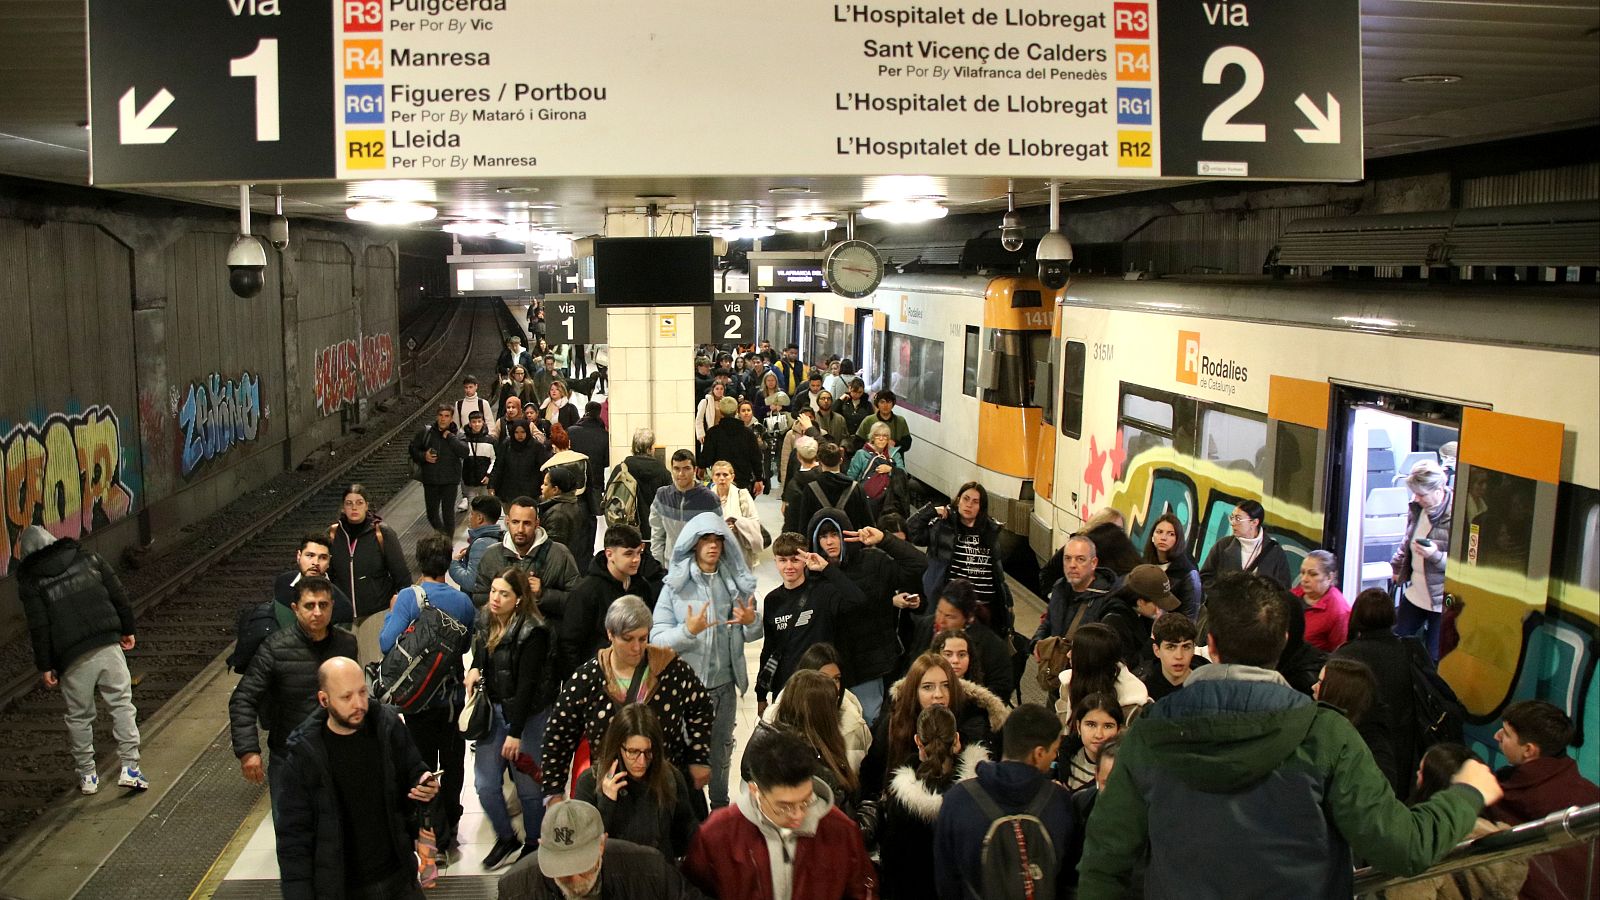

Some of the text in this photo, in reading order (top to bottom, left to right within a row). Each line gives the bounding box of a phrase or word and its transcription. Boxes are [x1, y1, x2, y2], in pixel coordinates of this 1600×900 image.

[344, 0, 382, 24] R3
[971, 8, 999, 26] de
[1006, 9, 1107, 33] Llobregat
[1115, 9, 1148, 32] R3
[1202, 0, 1249, 27] via
[390, 19, 493, 33] Per Por By Vic
[345, 47, 382, 71] R4
[390, 48, 490, 67] Manresa
[863, 40, 1107, 65] Sant Vicenç de Calders
[1117, 52, 1150, 74] R4
[878, 65, 1108, 81] Per Por By Vilafranca del Penedès
[230, 38, 280, 142] 1
[391, 82, 607, 105] Figueres / Portbou
[1202, 45, 1266, 142] 2
[346, 95, 384, 114] RG1
[973, 95, 1000, 113] de
[1007, 95, 1108, 118] Llobregat
[1118, 97, 1151, 115] RG1
[391, 110, 415, 122] Per
[420, 110, 444, 121] Por
[449, 110, 467, 124] By
[472, 109, 525, 122] Mataró
[538, 109, 587, 121] Girona
[391, 129, 461, 148] Lleida
[1119, 141, 1152, 158] R12
[348, 141, 385, 159] R12
[974, 138, 1001, 156] de
[1008, 138, 1109, 162] Llobregat
[392, 155, 537, 170] Per Por By Manresa
[558, 302, 576, 314] via
[724, 302, 741, 313] via
[561, 316, 574, 340] 1
[723, 315, 742, 339] 2
[1093, 342, 1114, 361] 315M
[1201, 355, 1248, 382] Rodalies
[1200, 377, 1236, 396] de Catalunya
